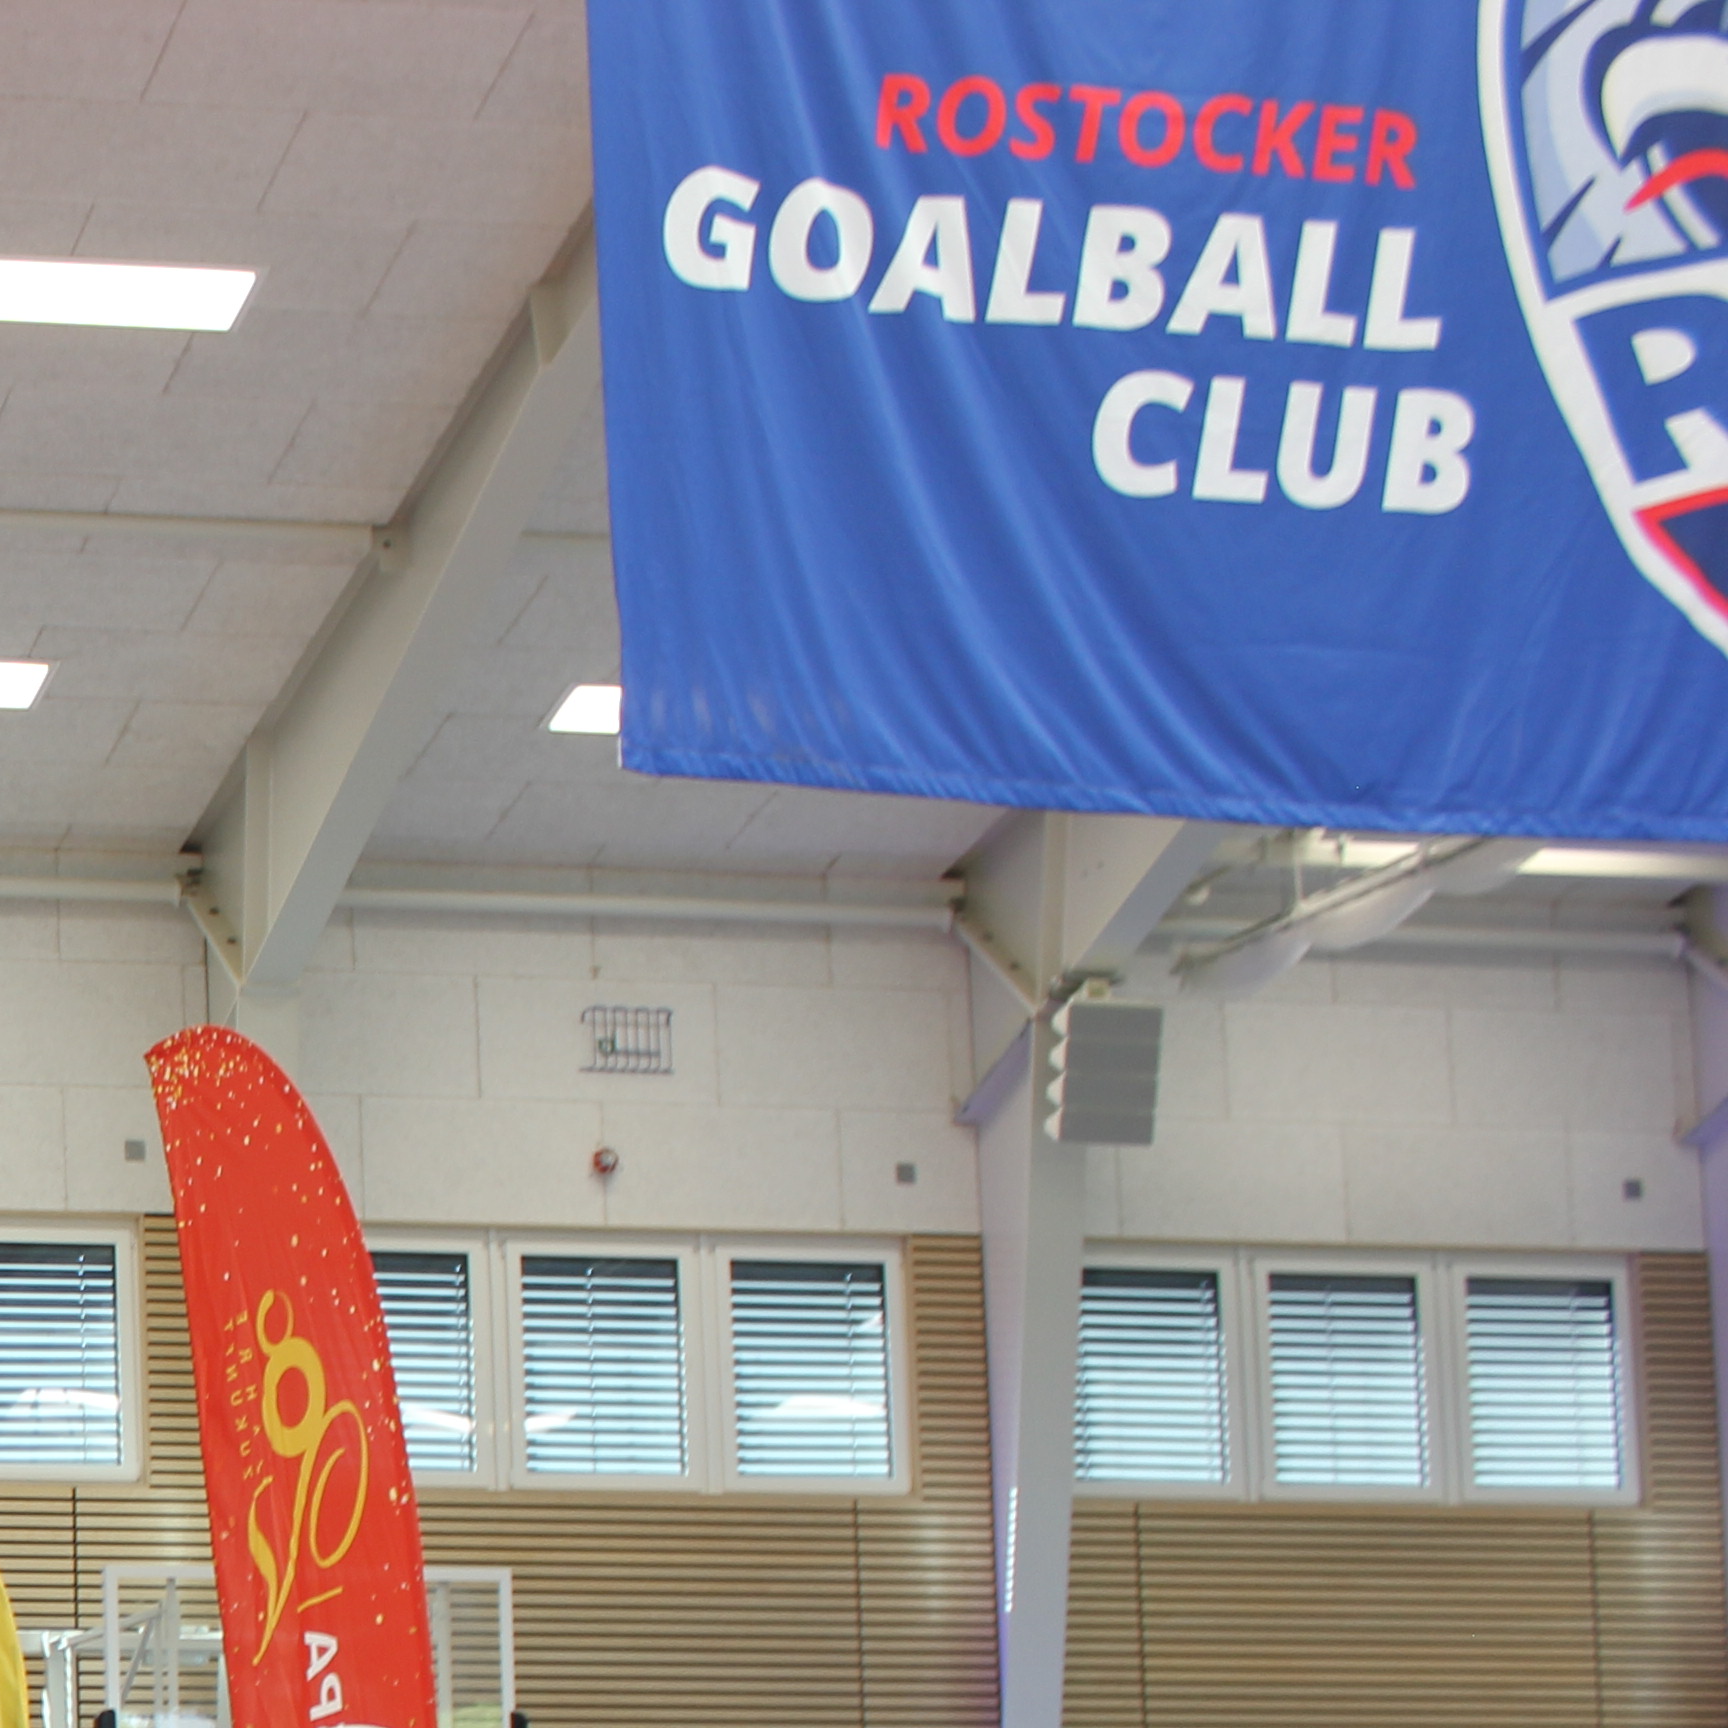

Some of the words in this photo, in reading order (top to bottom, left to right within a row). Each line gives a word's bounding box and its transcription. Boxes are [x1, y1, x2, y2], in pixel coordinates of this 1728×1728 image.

[875, 72, 1419, 190] ROSTOCKER
[661, 164, 1444, 354] GOALBALL
[1091, 370, 1475, 515] CLUB
